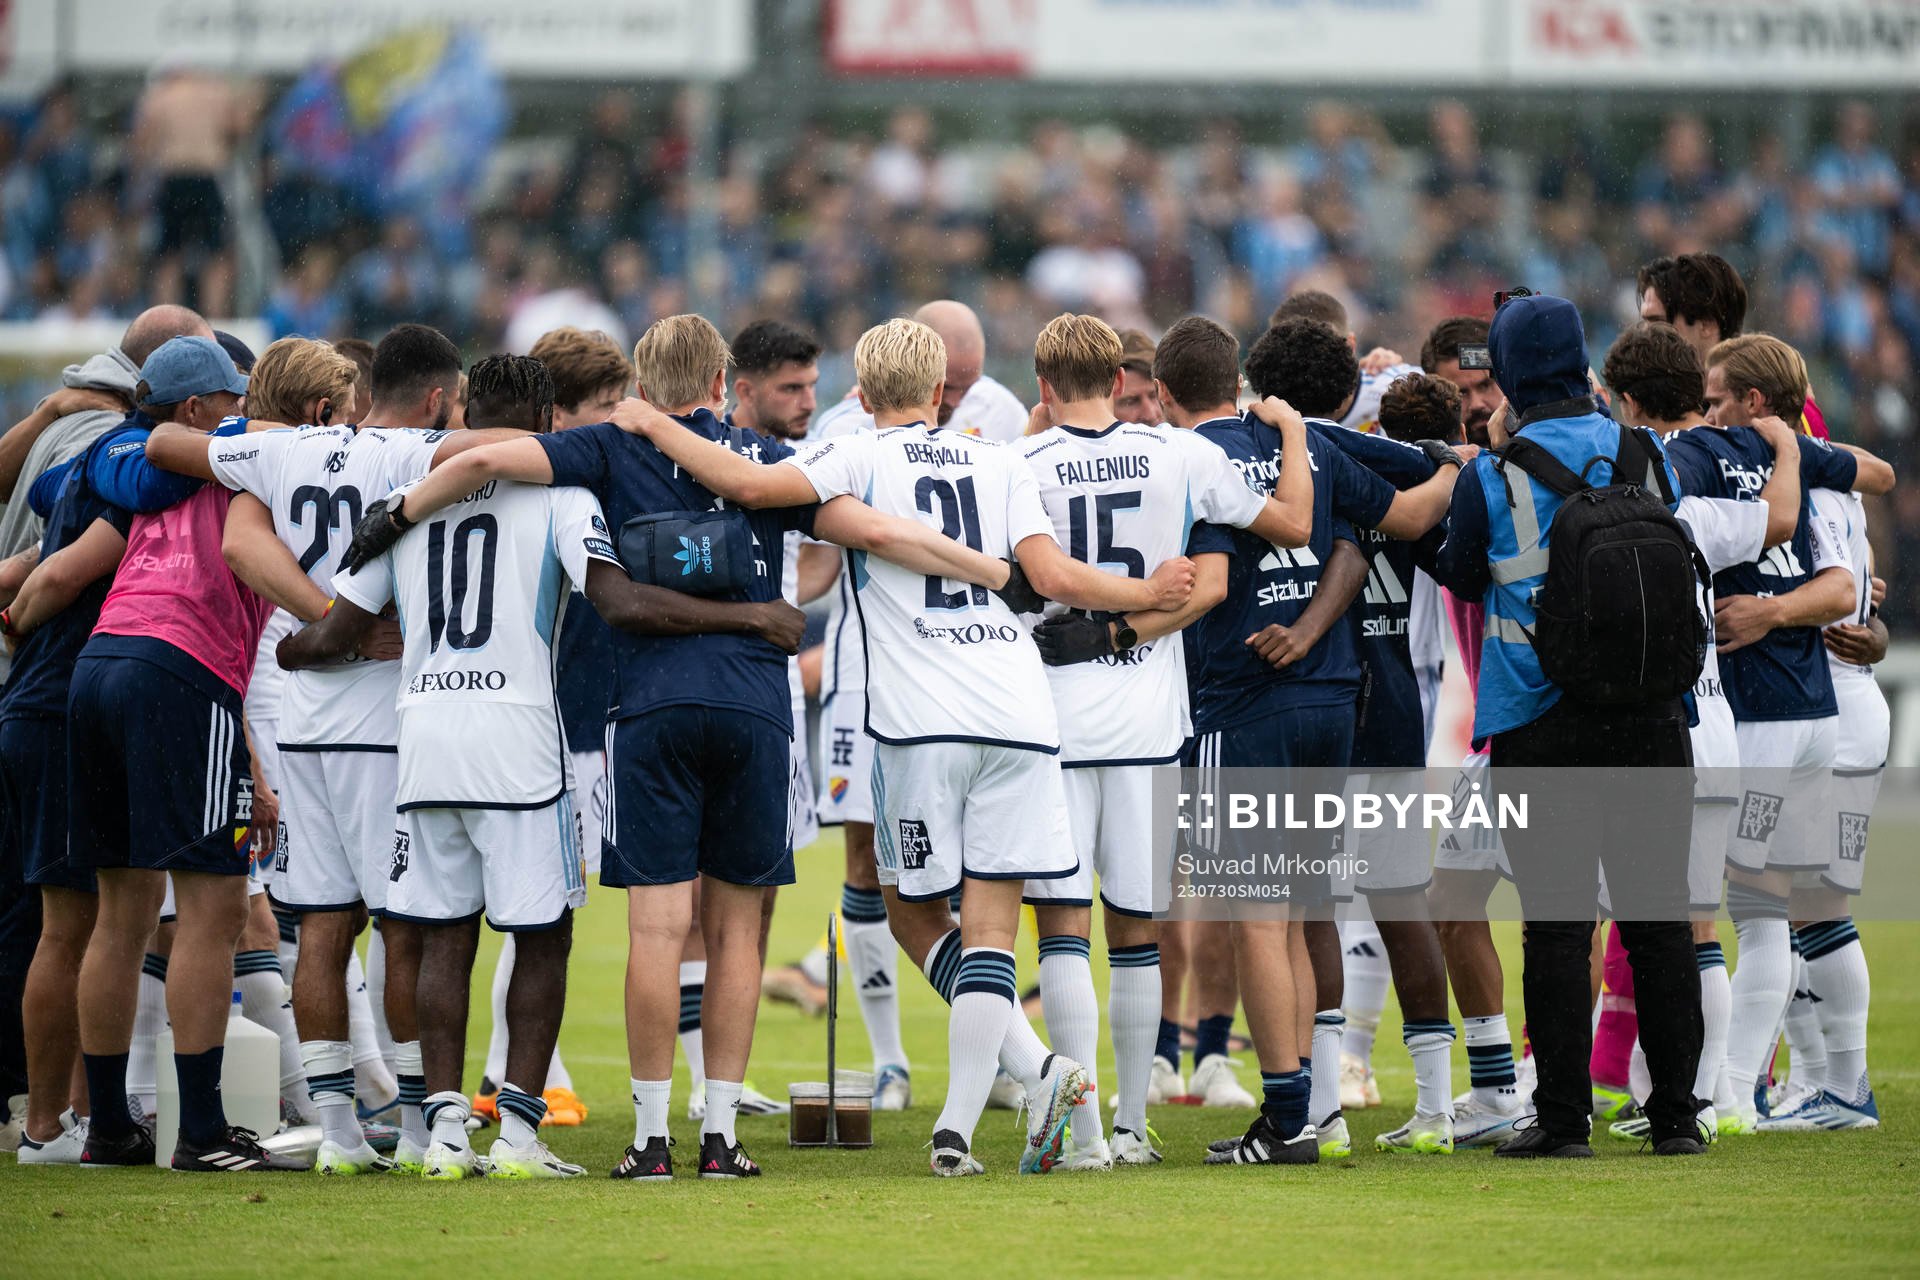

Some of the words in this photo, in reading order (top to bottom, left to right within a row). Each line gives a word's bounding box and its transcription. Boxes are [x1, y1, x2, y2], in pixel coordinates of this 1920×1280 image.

[217, 449, 260, 463] stadium
[1055, 455, 1150, 486] FALLENIUS
[701, 536, 712, 574] adidas
[915, 475, 989, 608] 21
[1069, 490, 1146, 617] 15
[427, 513, 498, 655] 10
[419, 670, 507, 693] FXORO
